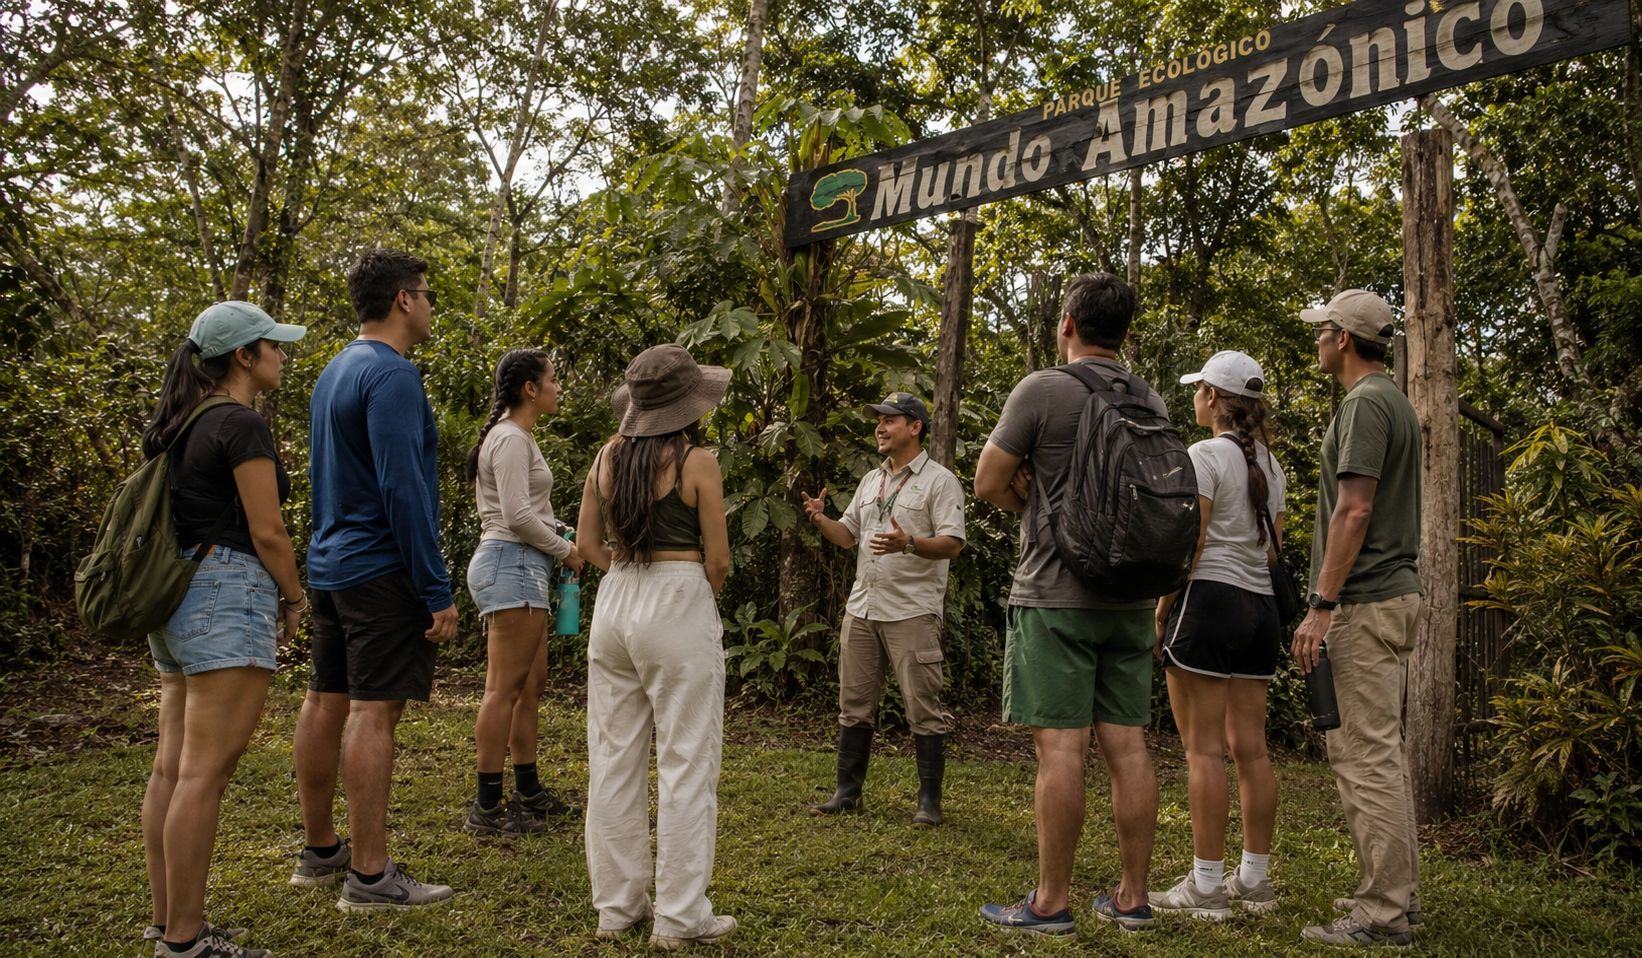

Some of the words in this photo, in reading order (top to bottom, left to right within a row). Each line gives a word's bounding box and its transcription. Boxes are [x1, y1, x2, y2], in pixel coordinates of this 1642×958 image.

[870, 126, 1051, 221] Mundo
[1081, 0, 1545, 172] Amazónico
[1042, 79, 1121, 120] PARQUE
[1138, 30, 1271, 89] ECOLÓGICO
